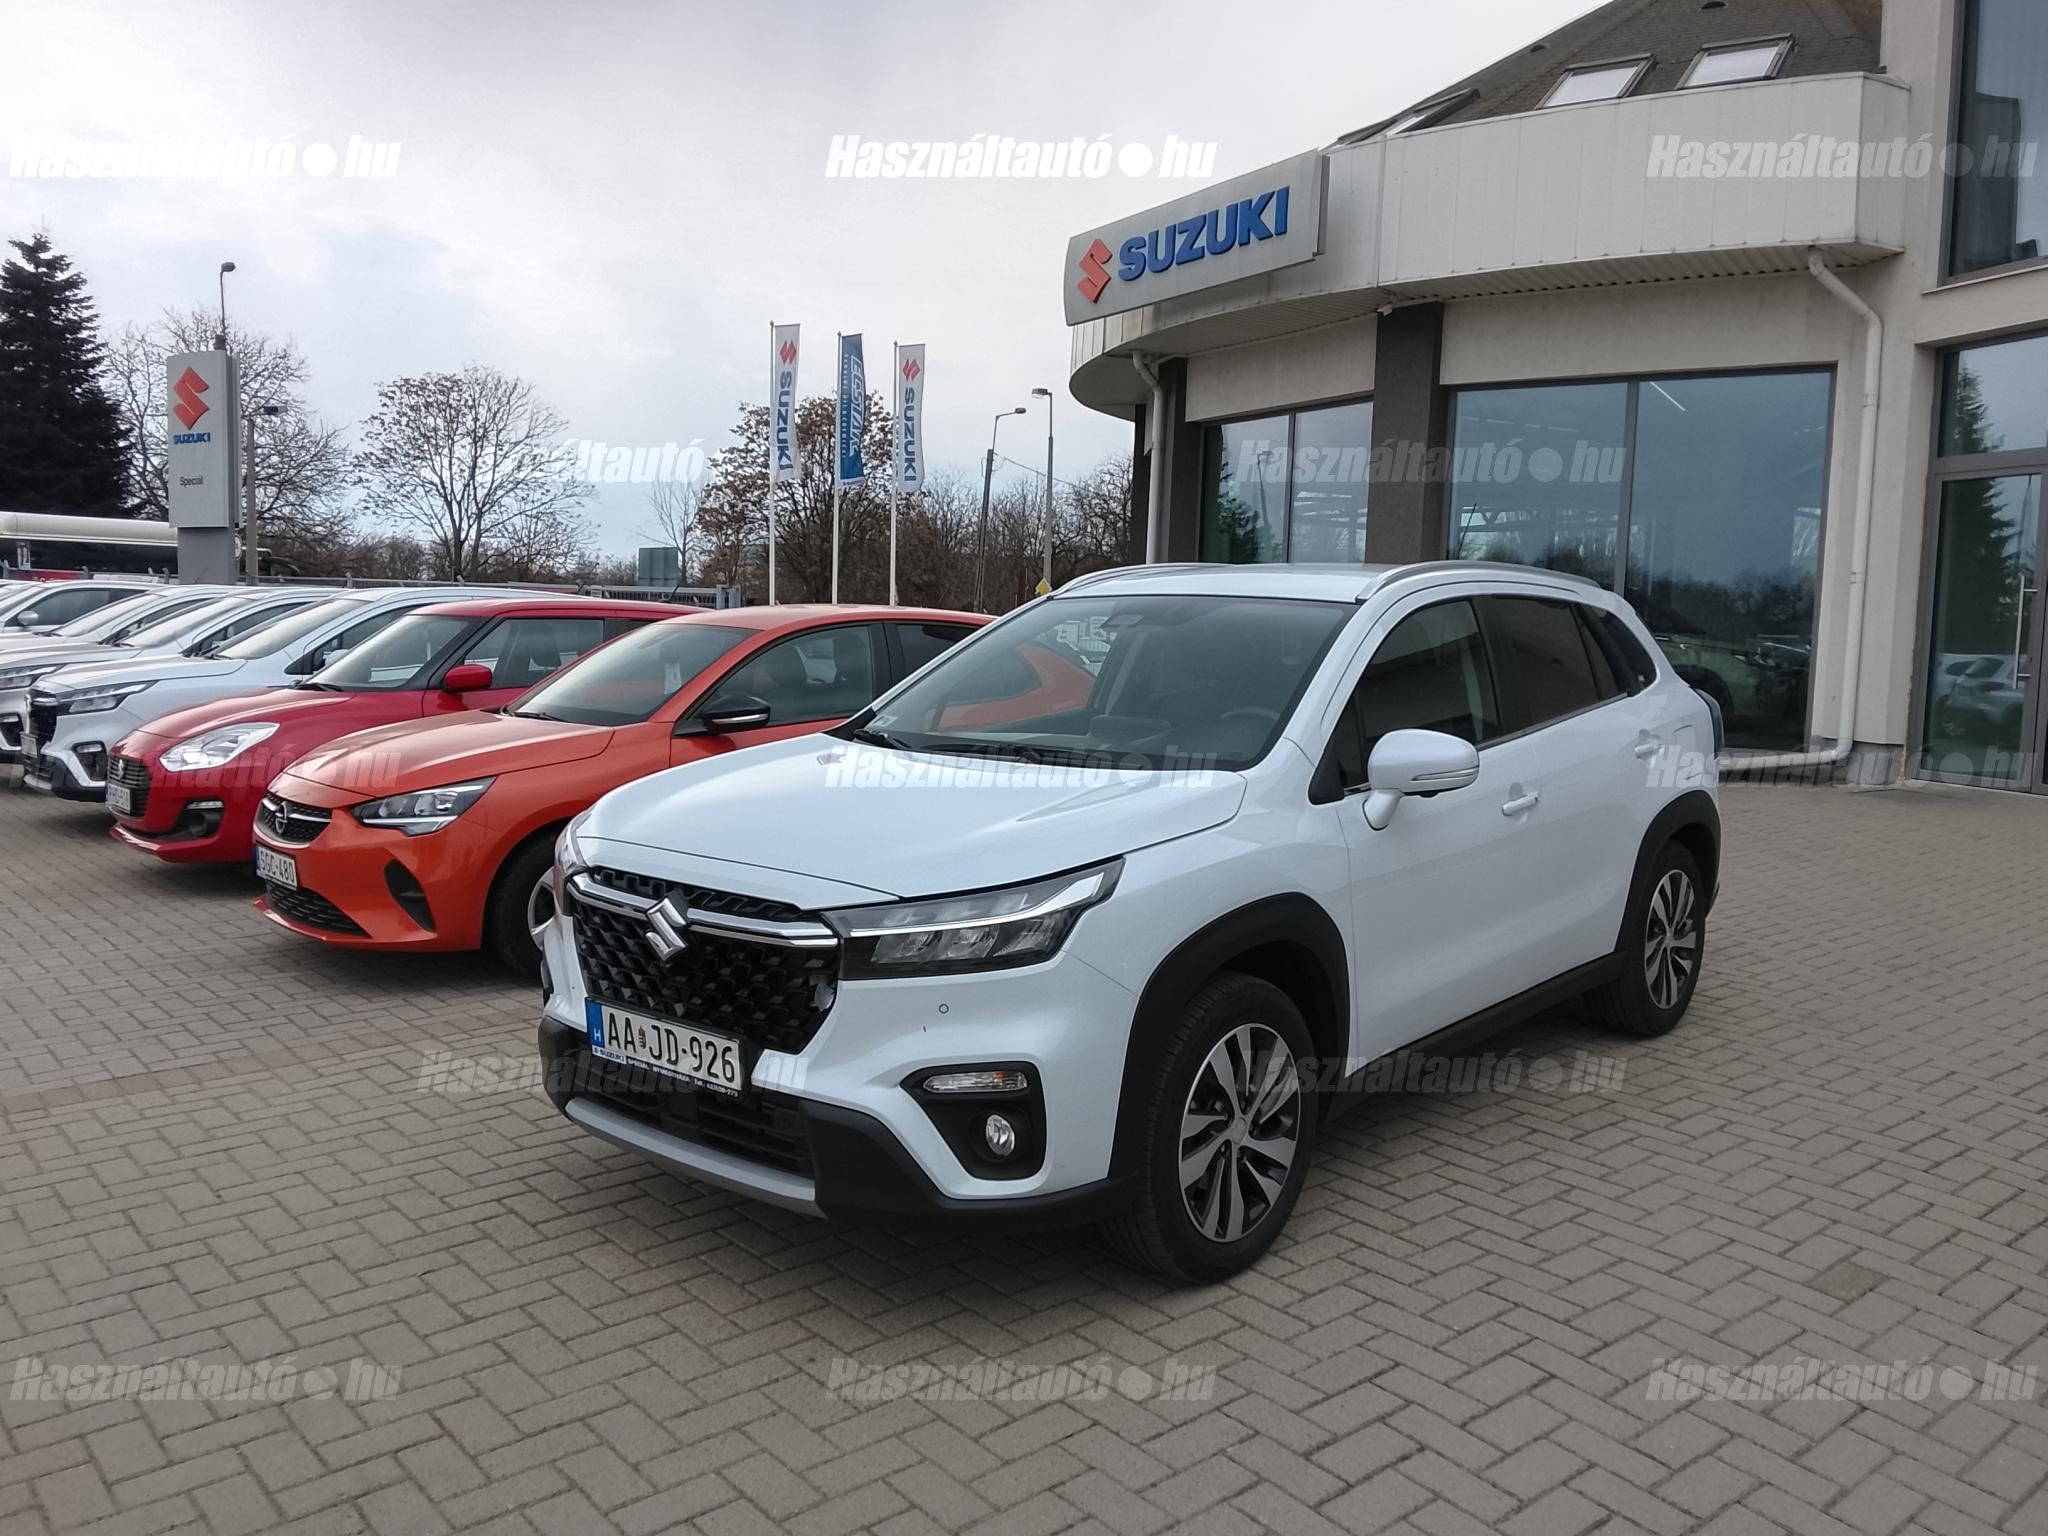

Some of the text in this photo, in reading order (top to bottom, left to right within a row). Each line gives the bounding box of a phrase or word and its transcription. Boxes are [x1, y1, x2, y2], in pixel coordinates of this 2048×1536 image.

[1118, 186, 1290, 281] SUZUKI
[173, 431, 211, 444] SUZUKI
[776, 370, 793, 470] SUZUKI
[903, 387, 917, 481] SUZUKI
[260, 849, 295, 883] SGC-480
[599, 1049, 625, 1064] SUZUKI
